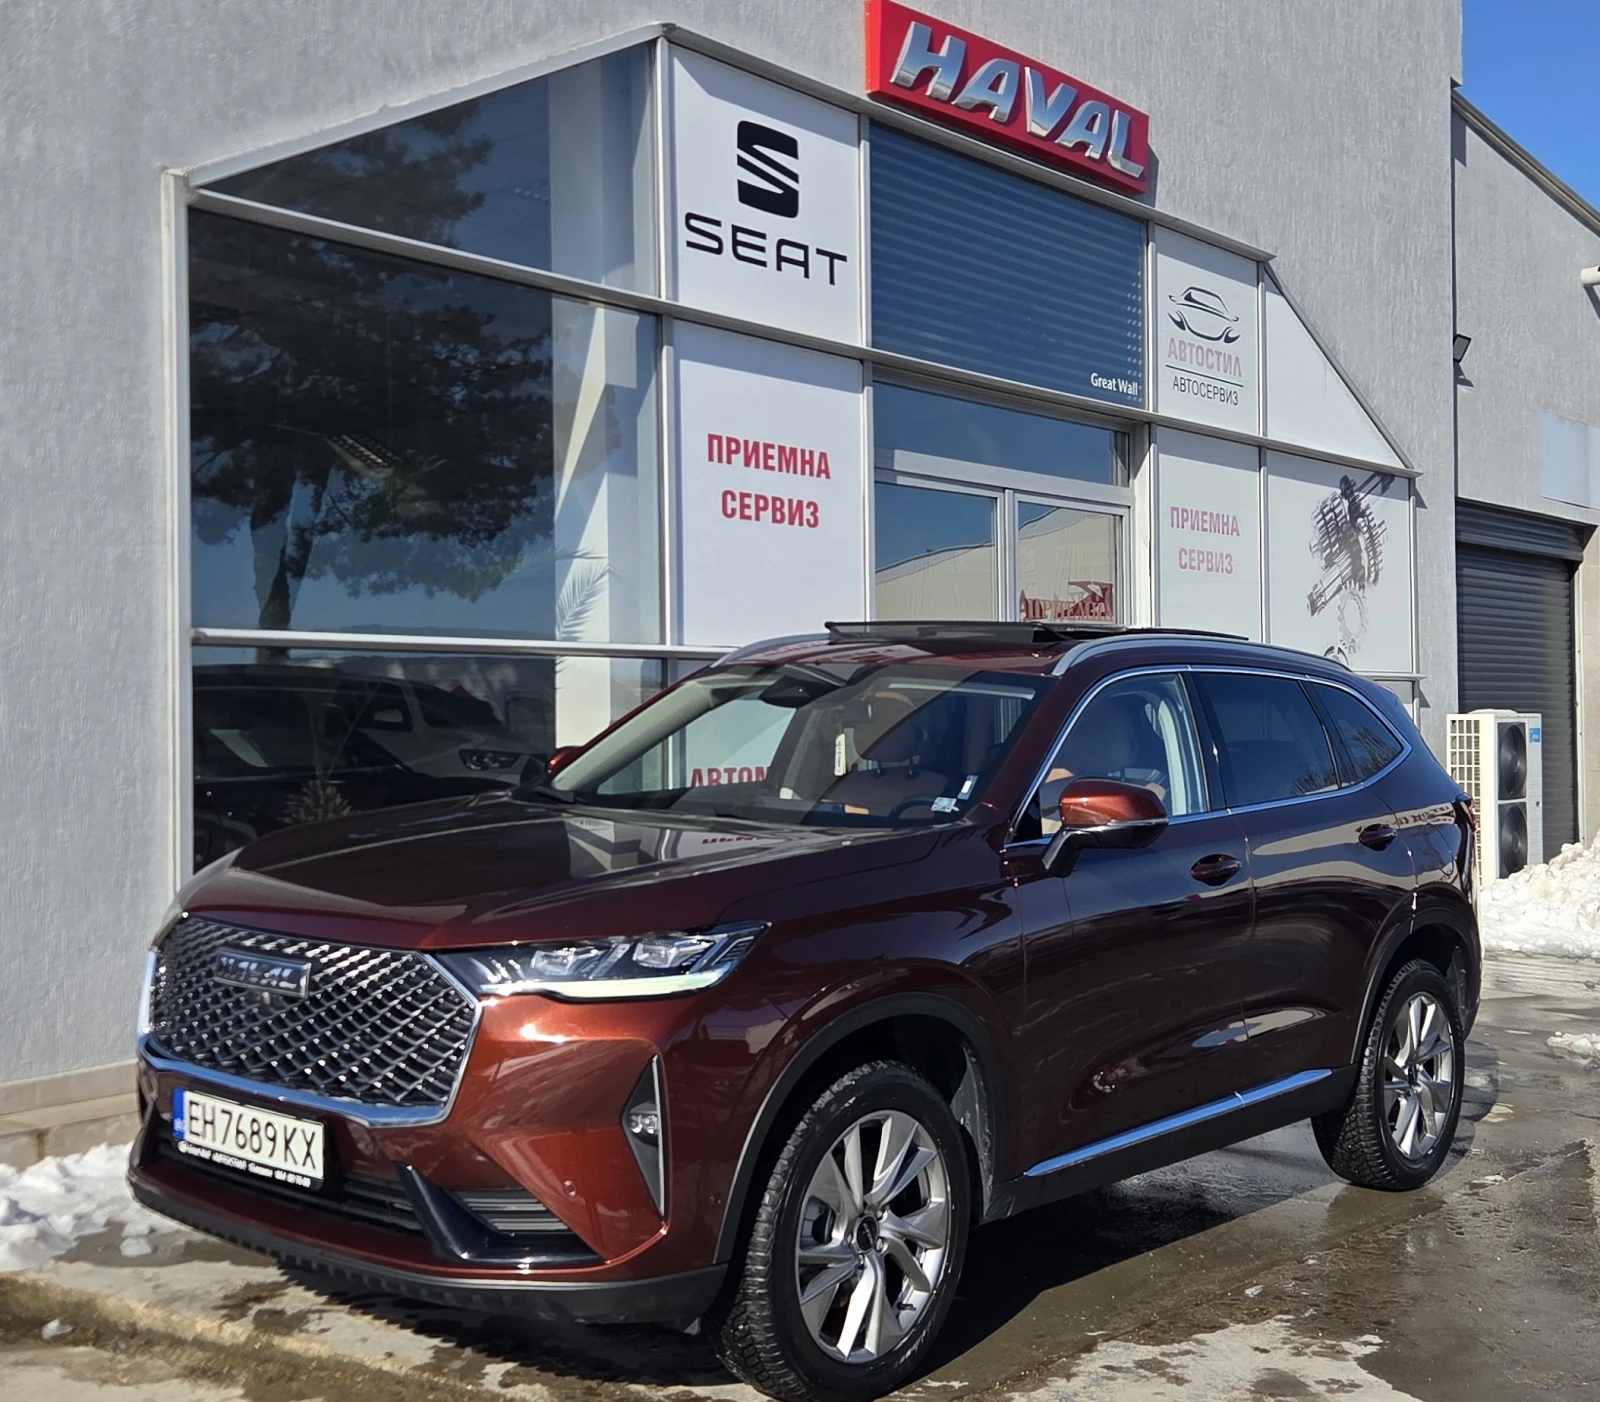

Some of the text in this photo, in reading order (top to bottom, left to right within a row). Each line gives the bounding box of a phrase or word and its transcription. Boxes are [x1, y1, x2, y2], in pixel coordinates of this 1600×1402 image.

[891, 21, 1144, 178] HAVAL
[685, 211, 847, 285] SEAT
[1168, 337, 1242, 378] АВТОСТИЛ
[1091, 372, 1138, 396] Great Wall
[1173, 375, 1239, 406] АВТОСЕРВИЗ
[708, 434, 830, 479] ПРИЕМНА
[722, 489, 819, 529] СЕРВИЗ
[1170, 505, 1240, 537] ПРИЕМНА
[1178, 547, 1233, 575] СЕРВИЗ
[188, 1101, 317, 1170] EH7689KX
